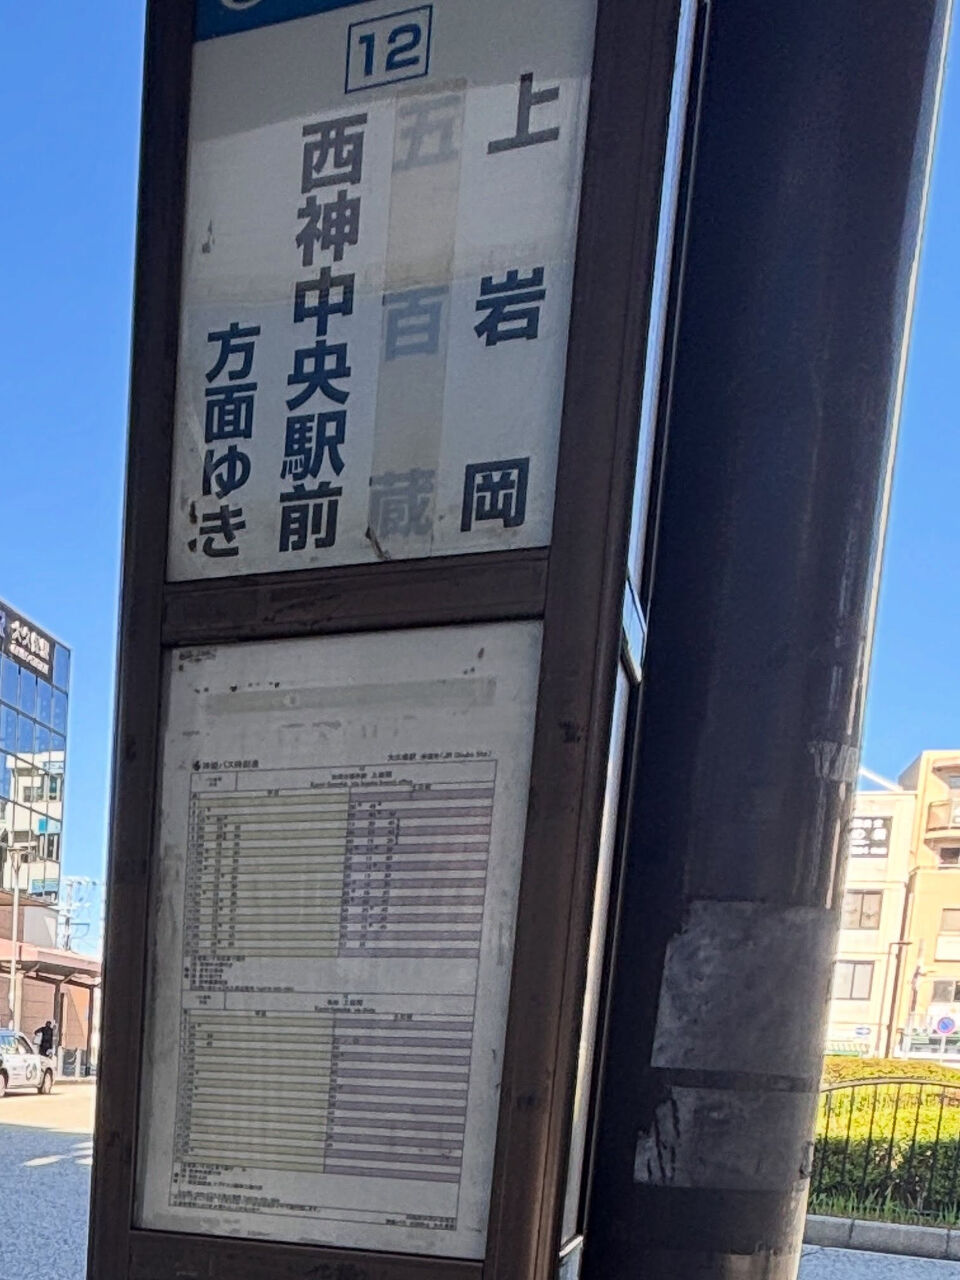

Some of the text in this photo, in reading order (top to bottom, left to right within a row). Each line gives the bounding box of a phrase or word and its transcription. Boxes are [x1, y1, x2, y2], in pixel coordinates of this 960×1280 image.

[357, 22, 423, 77] 12
[196, 321, 262, 559] 方面ゆき
[278, 111, 369, 554] 西神中央駅前
[459, 71, 560, 533] 上岩岡
